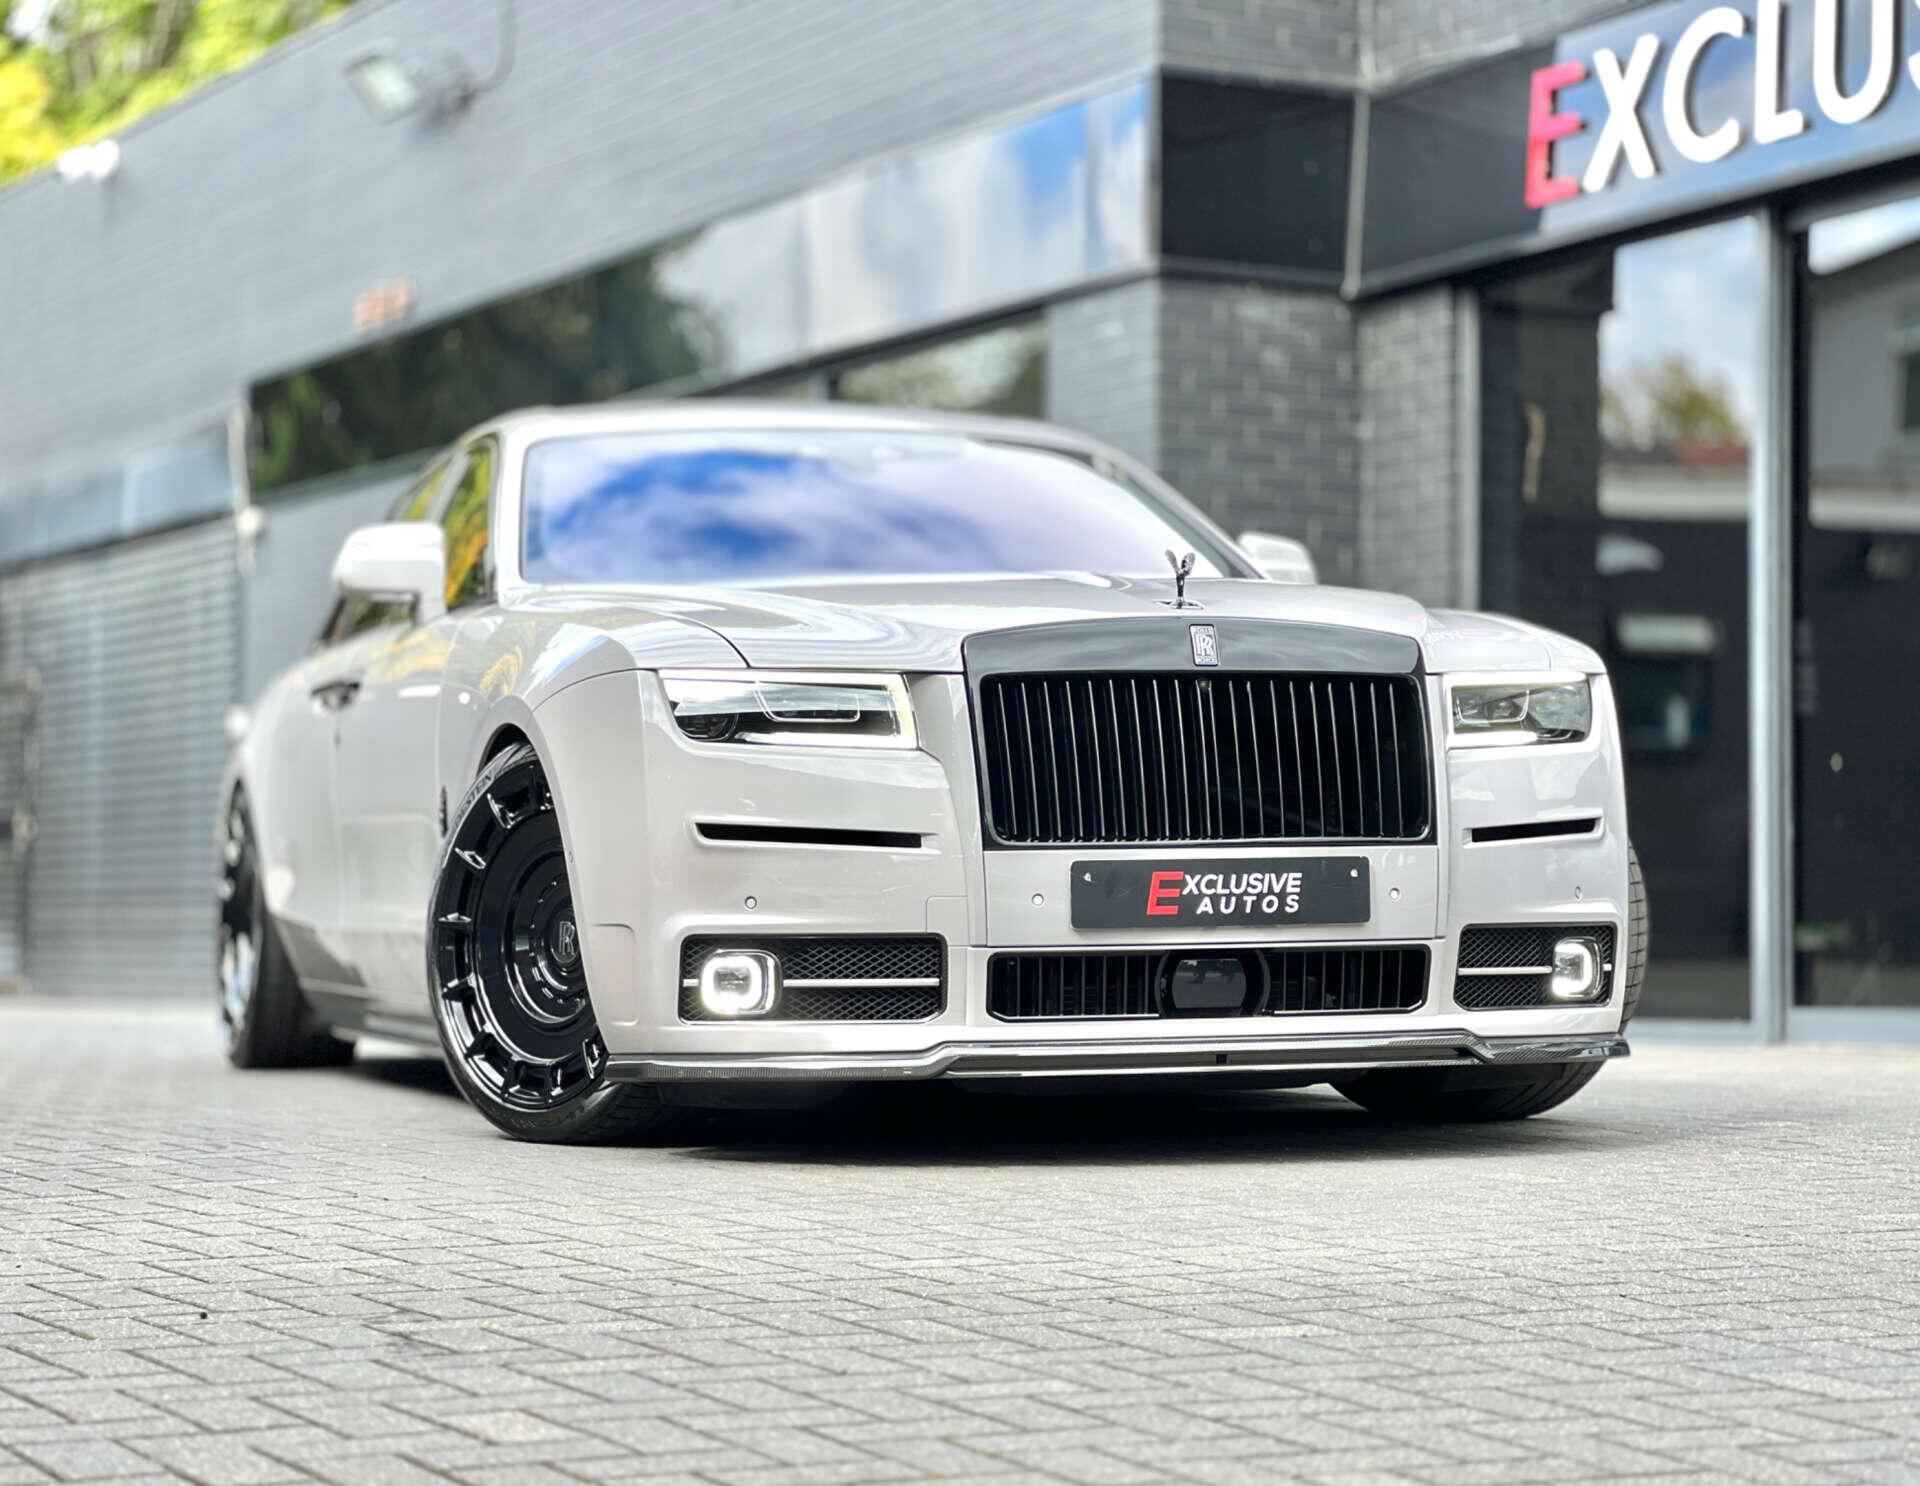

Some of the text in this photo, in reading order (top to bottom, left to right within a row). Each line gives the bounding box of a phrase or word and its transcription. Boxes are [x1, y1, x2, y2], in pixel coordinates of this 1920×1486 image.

[1525, 0, 1920, 209] EXCLU
[1146, 871, 1303, 915] EXCLUSIVE
[1196, 895, 1300, 914] AUTOS
